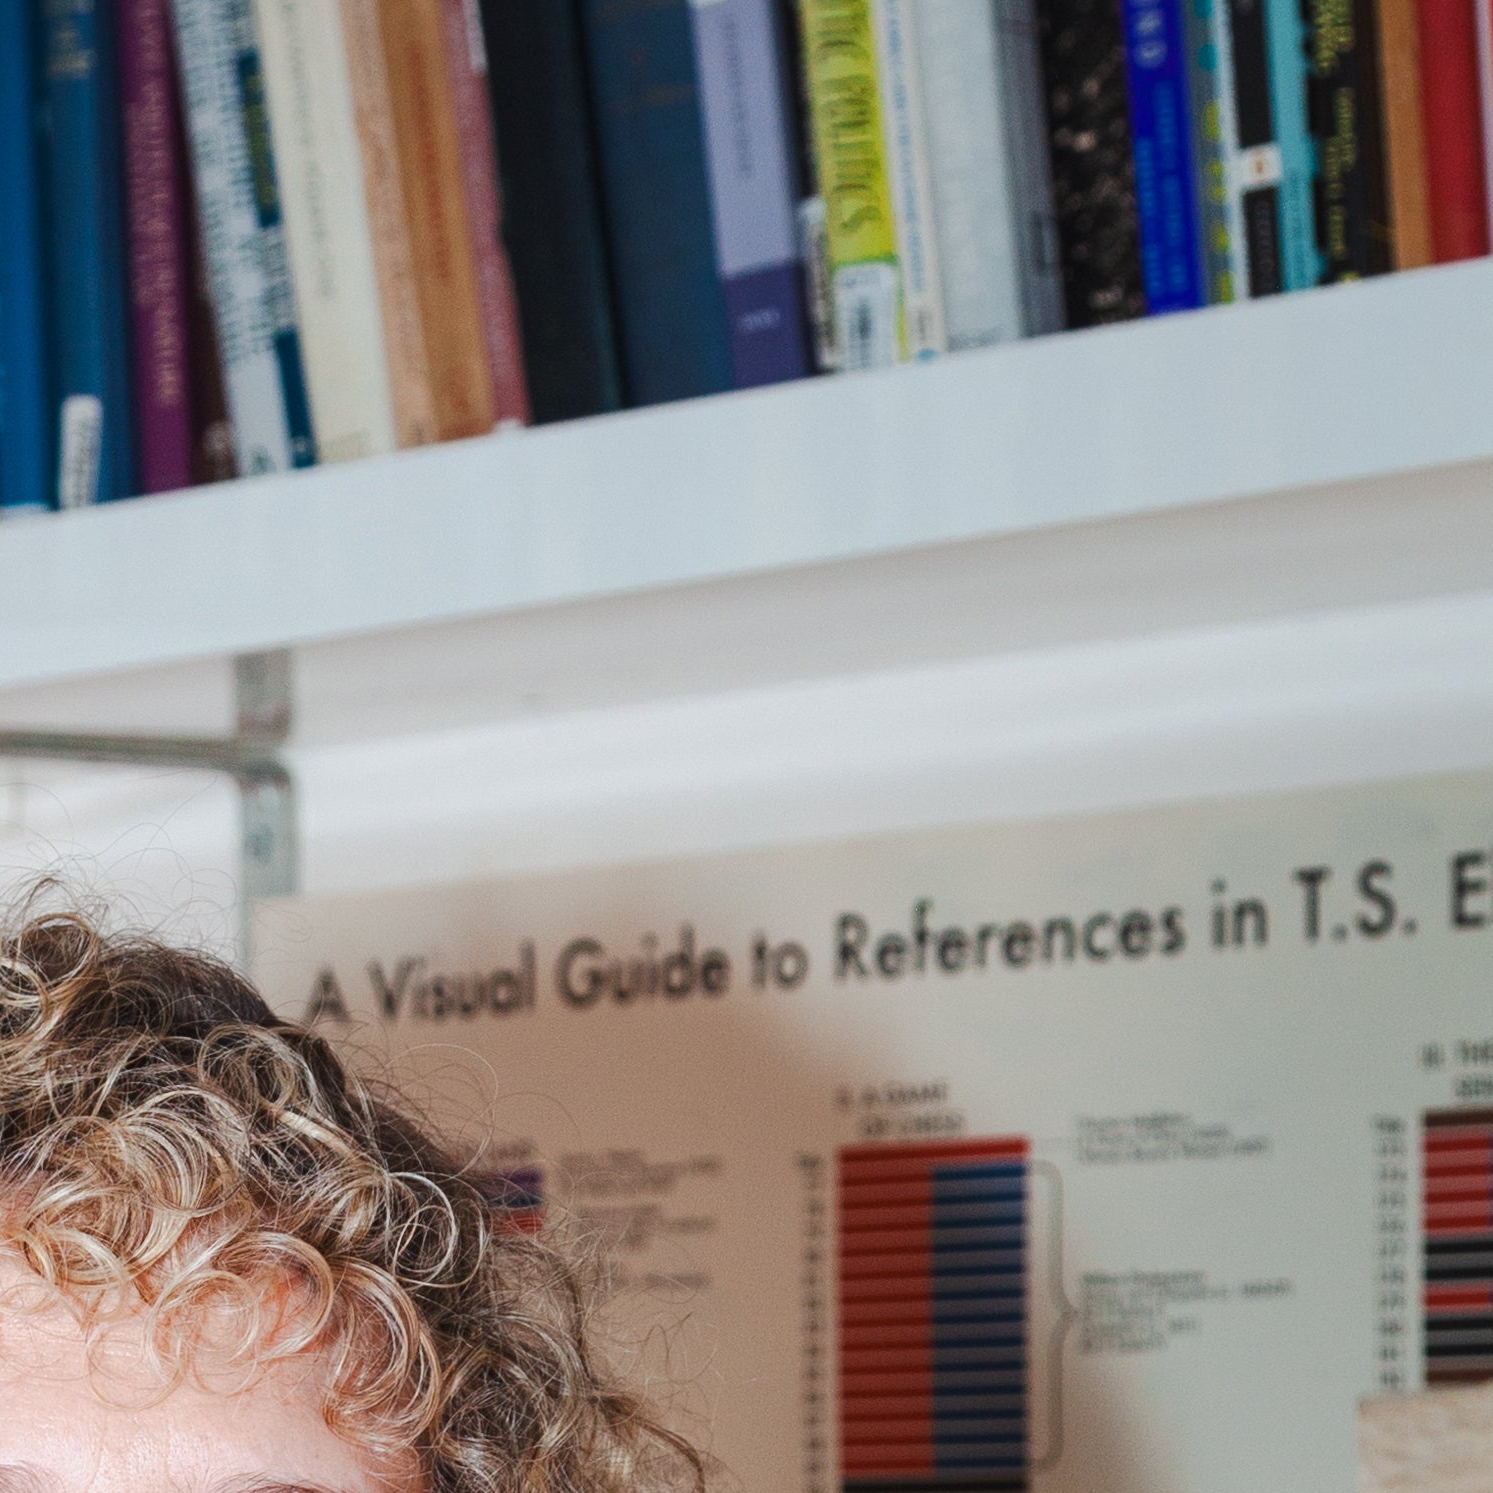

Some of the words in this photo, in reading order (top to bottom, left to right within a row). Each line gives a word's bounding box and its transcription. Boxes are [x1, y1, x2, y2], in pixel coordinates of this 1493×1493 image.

[309, 966, 351, 1025] A
[367, 939, 537, 1021] Visual
[555, 920, 731, 1010] Guide
[751, 930, 809, 989] to
[834, 898, 1186, 983] References
[1211, 878, 1269, 948] in
[1293, 859, 1418, 945] T.S.
